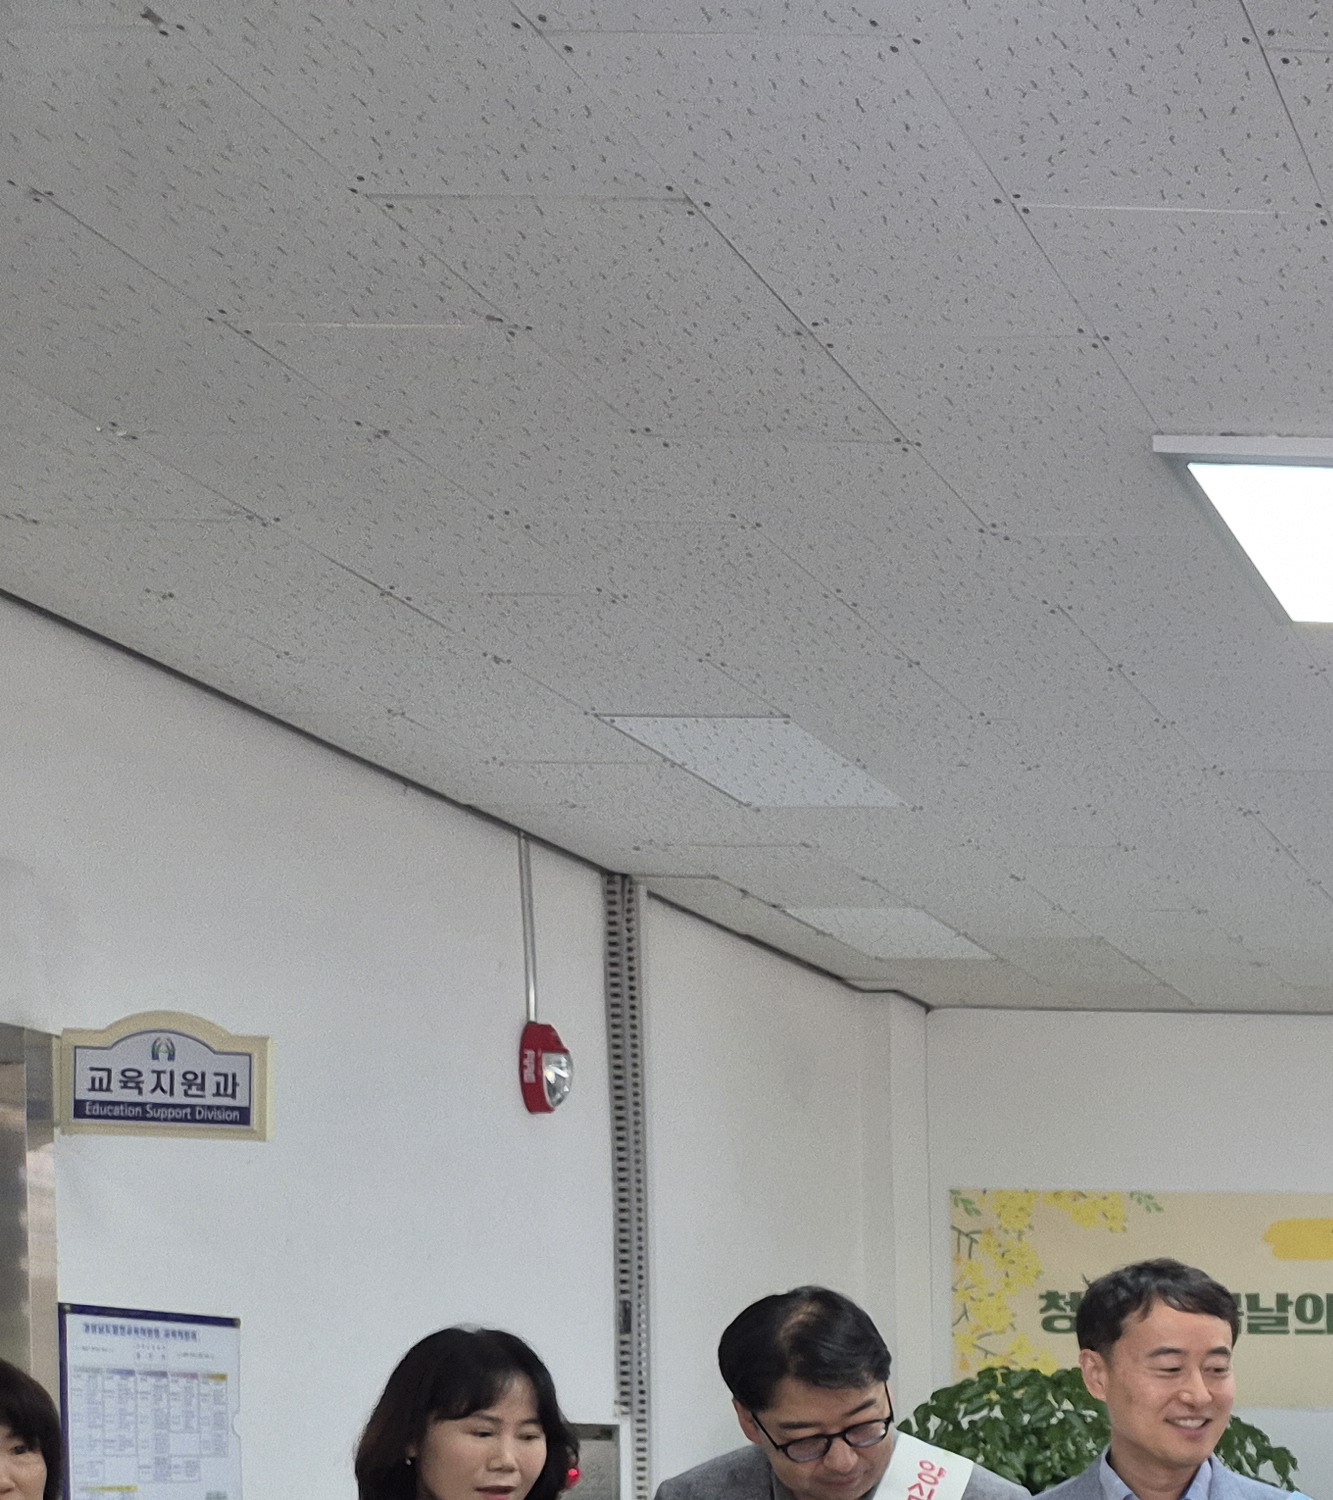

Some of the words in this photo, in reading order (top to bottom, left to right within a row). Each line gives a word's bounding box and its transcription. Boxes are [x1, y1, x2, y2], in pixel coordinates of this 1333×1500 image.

[87, 1066, 240, 1100] 교육지원과
[85, 1101, 143, 1117] Education
[146, 1105, 191, 1121] Support
[195, 1106, 240, 1122] Division
